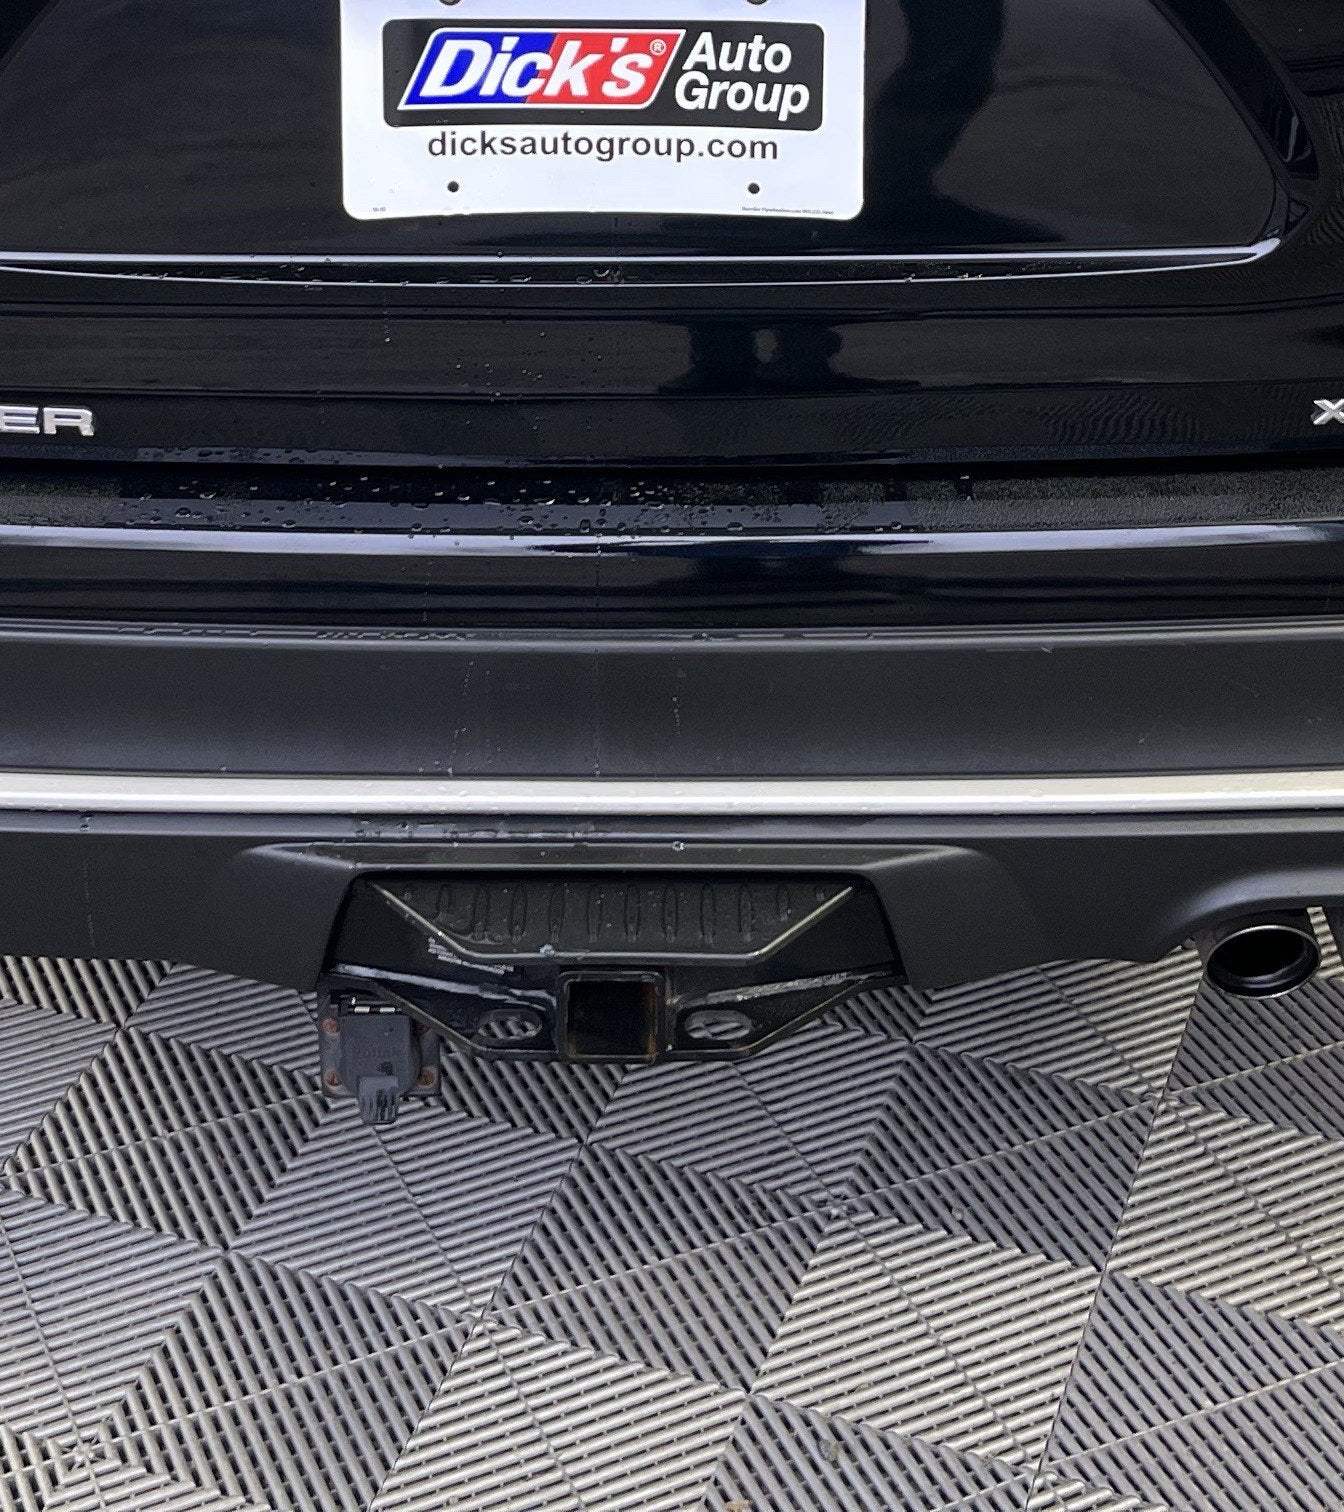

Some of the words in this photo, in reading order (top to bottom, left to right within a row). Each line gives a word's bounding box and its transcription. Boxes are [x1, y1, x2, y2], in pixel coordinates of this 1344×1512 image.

[682, 31, 792, 74] Auto
[675, 70, 810, 122] Group
[427, 130, 778, 163] dicksautogroup.com
